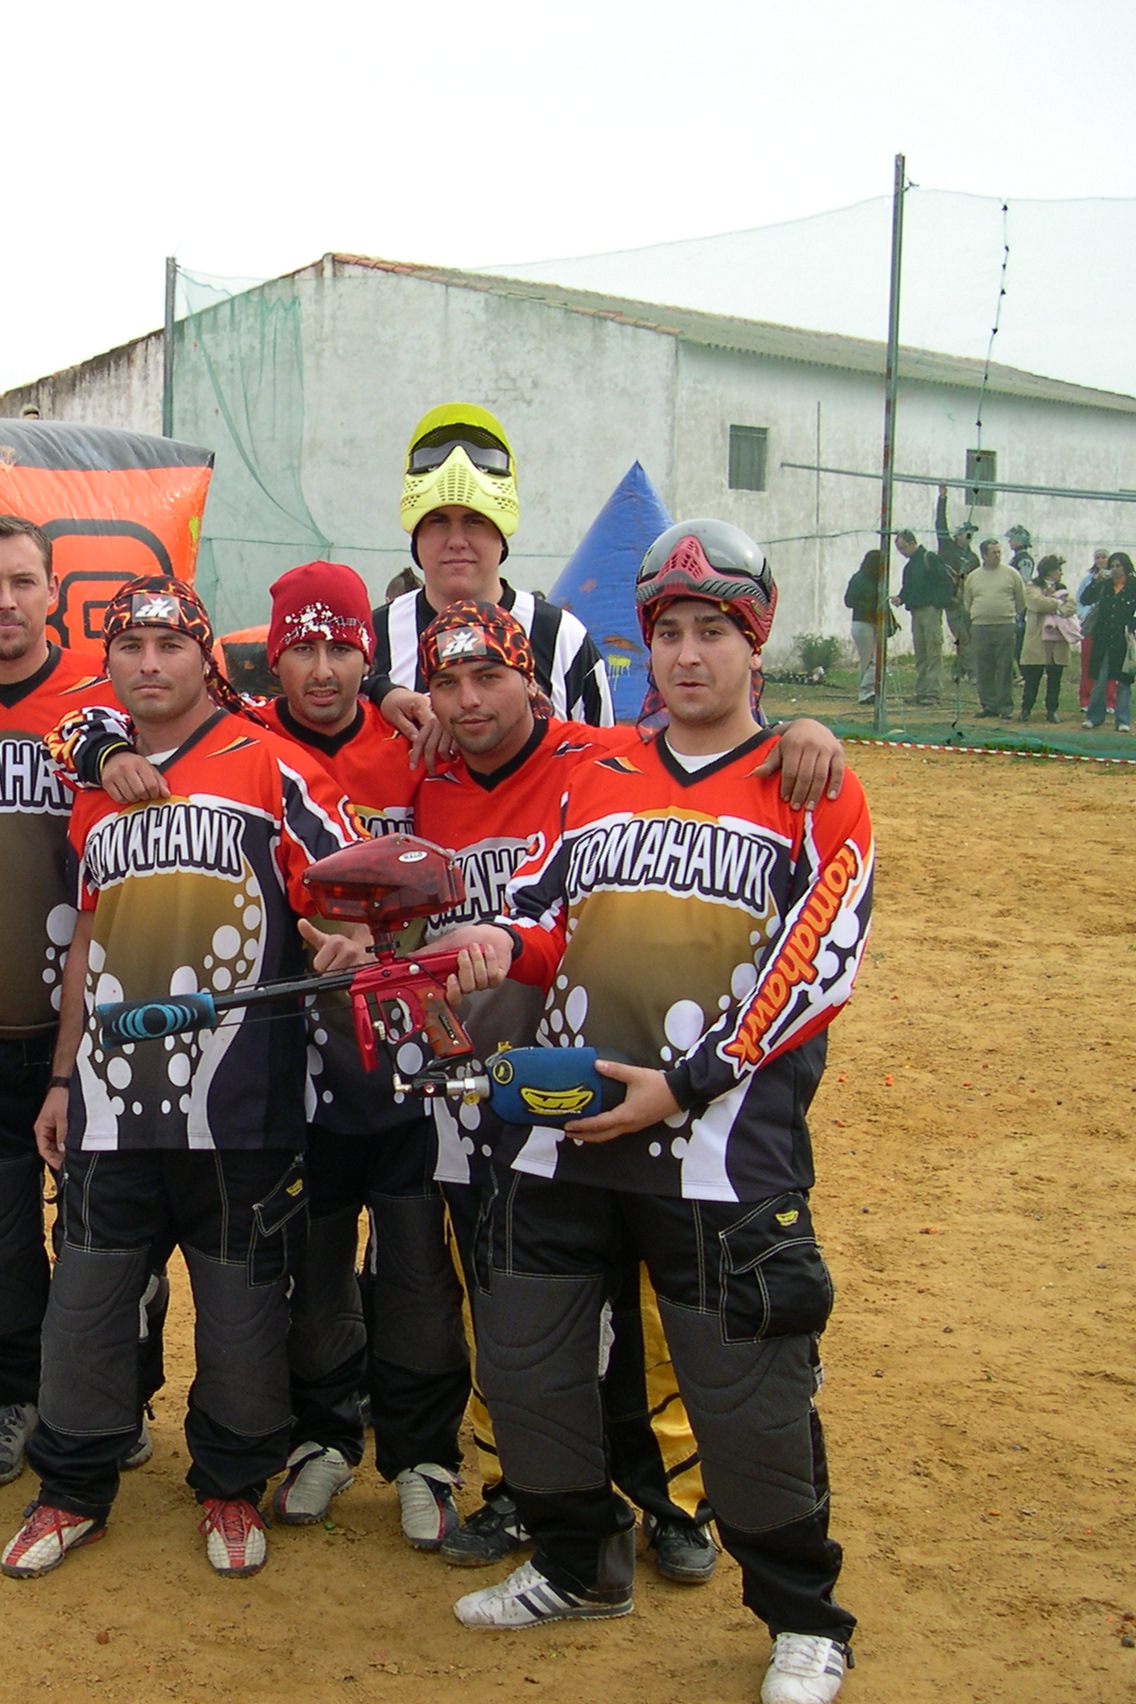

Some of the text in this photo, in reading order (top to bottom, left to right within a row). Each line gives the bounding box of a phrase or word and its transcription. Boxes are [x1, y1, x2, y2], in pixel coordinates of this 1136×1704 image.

[85, 804, 242, 884] OMAHAWK
[568, 819, 772, 911] TOMAHAWK
[725, 846, 857, 1066] tomahawk
